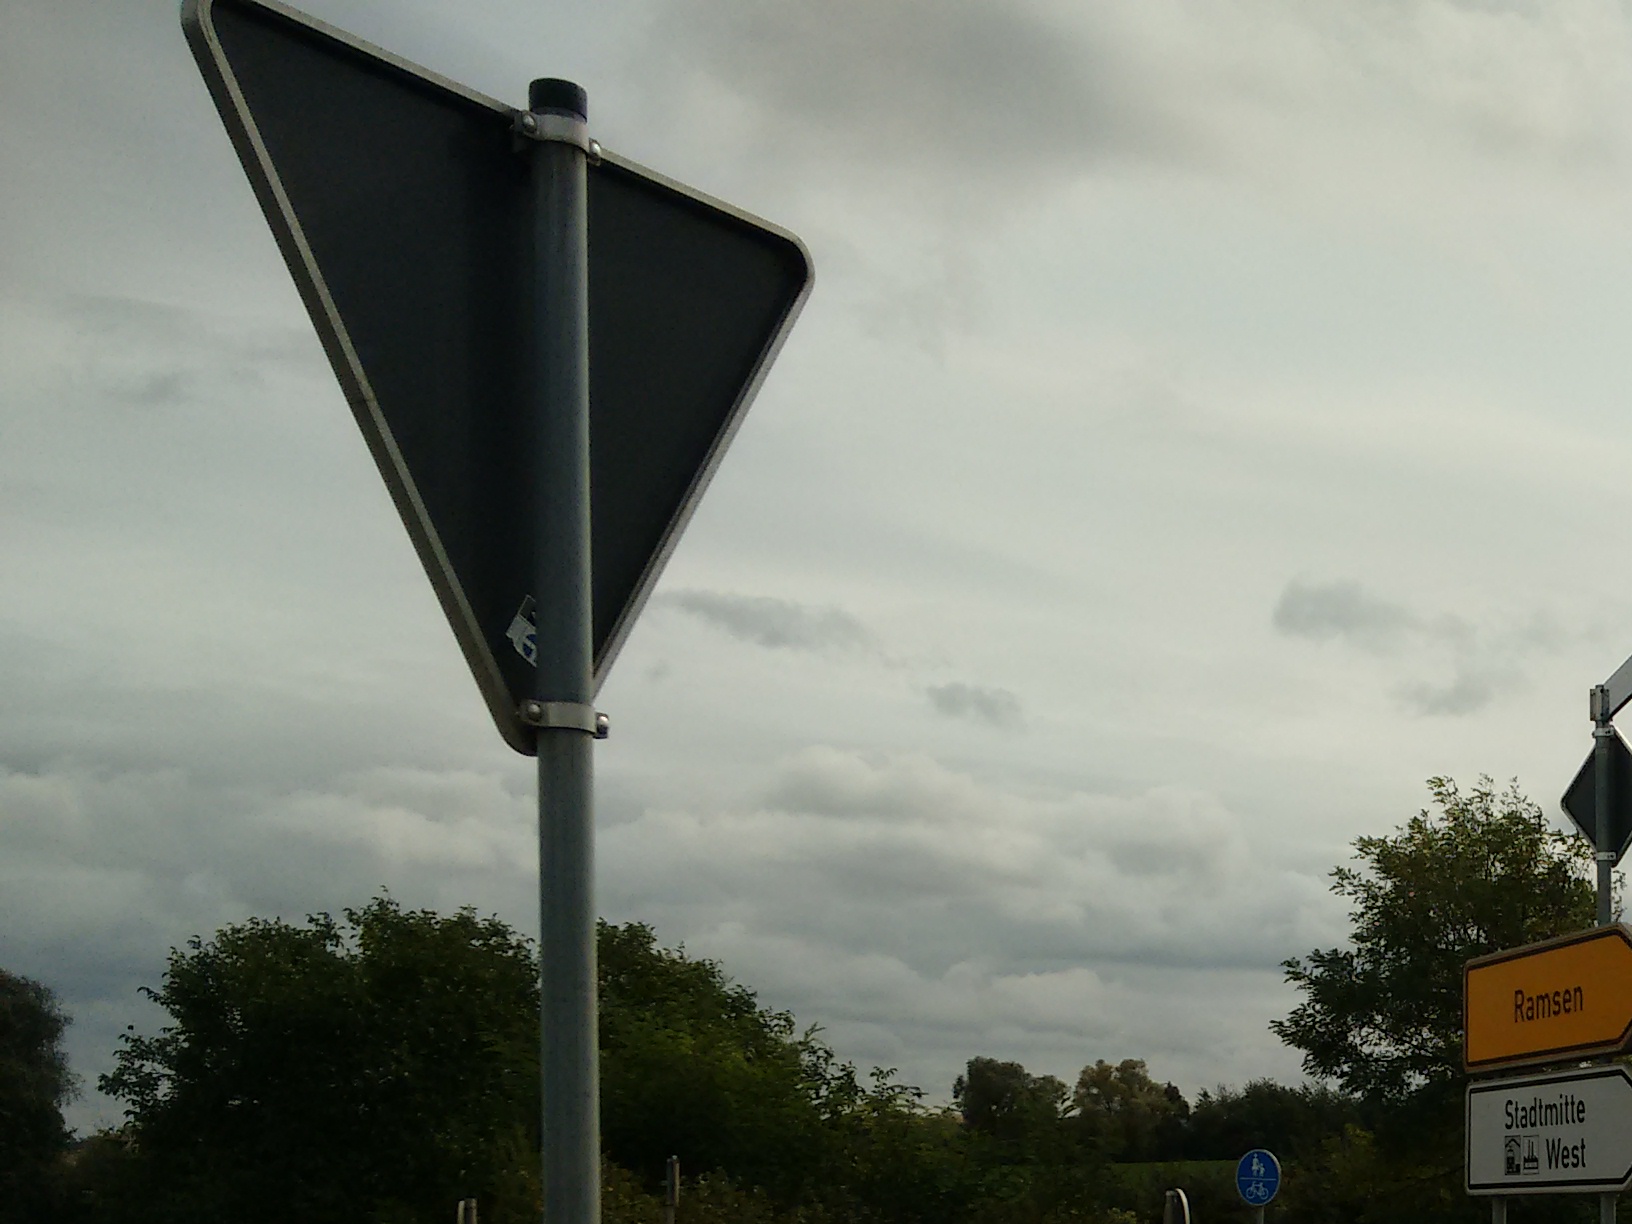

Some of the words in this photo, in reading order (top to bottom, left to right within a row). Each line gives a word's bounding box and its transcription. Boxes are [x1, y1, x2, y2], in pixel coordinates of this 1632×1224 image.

[1514, 985, 1584, 1023] Ramsen
[1504, 1093, 1586, 1130] Stadtmitte
[1545, 1138, 1587, 1170] West
